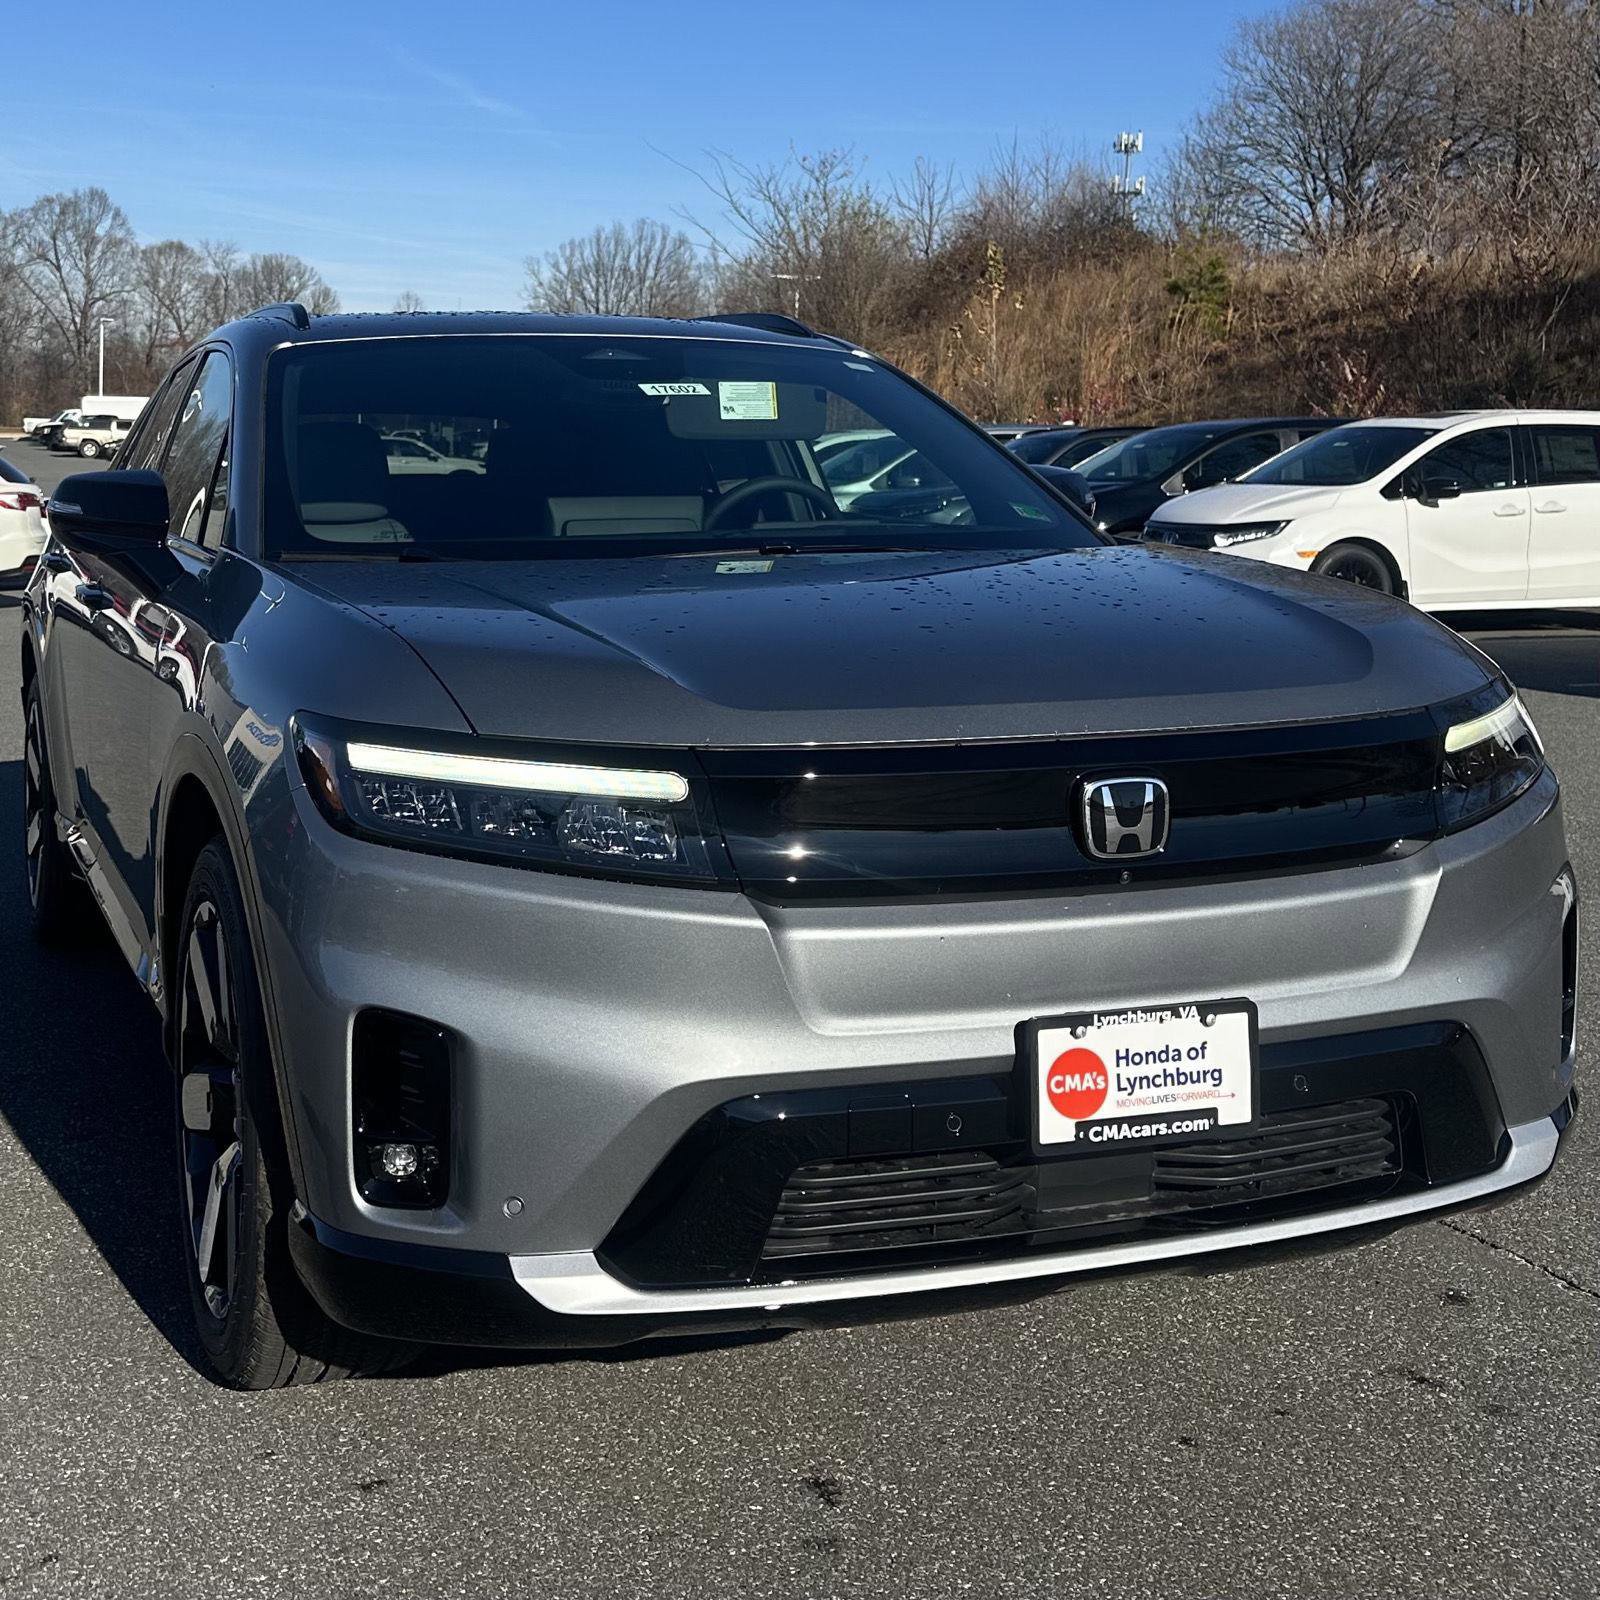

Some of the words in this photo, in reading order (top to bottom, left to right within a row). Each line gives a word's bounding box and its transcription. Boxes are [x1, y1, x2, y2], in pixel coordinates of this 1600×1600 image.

[650, 384, 701, 394] 17602
[1178, 1005, 1201, 1021] VA
[1115, 1044, 1182, 1068] Honda
[1186, 1041, 1207, 1061] of
[1050, 1071, 1106, 1095] CMA's
[1116, 1067, 1223, 1096] Lynchburg
[1088, 1117, 1210, 1143] CMAcars.com
